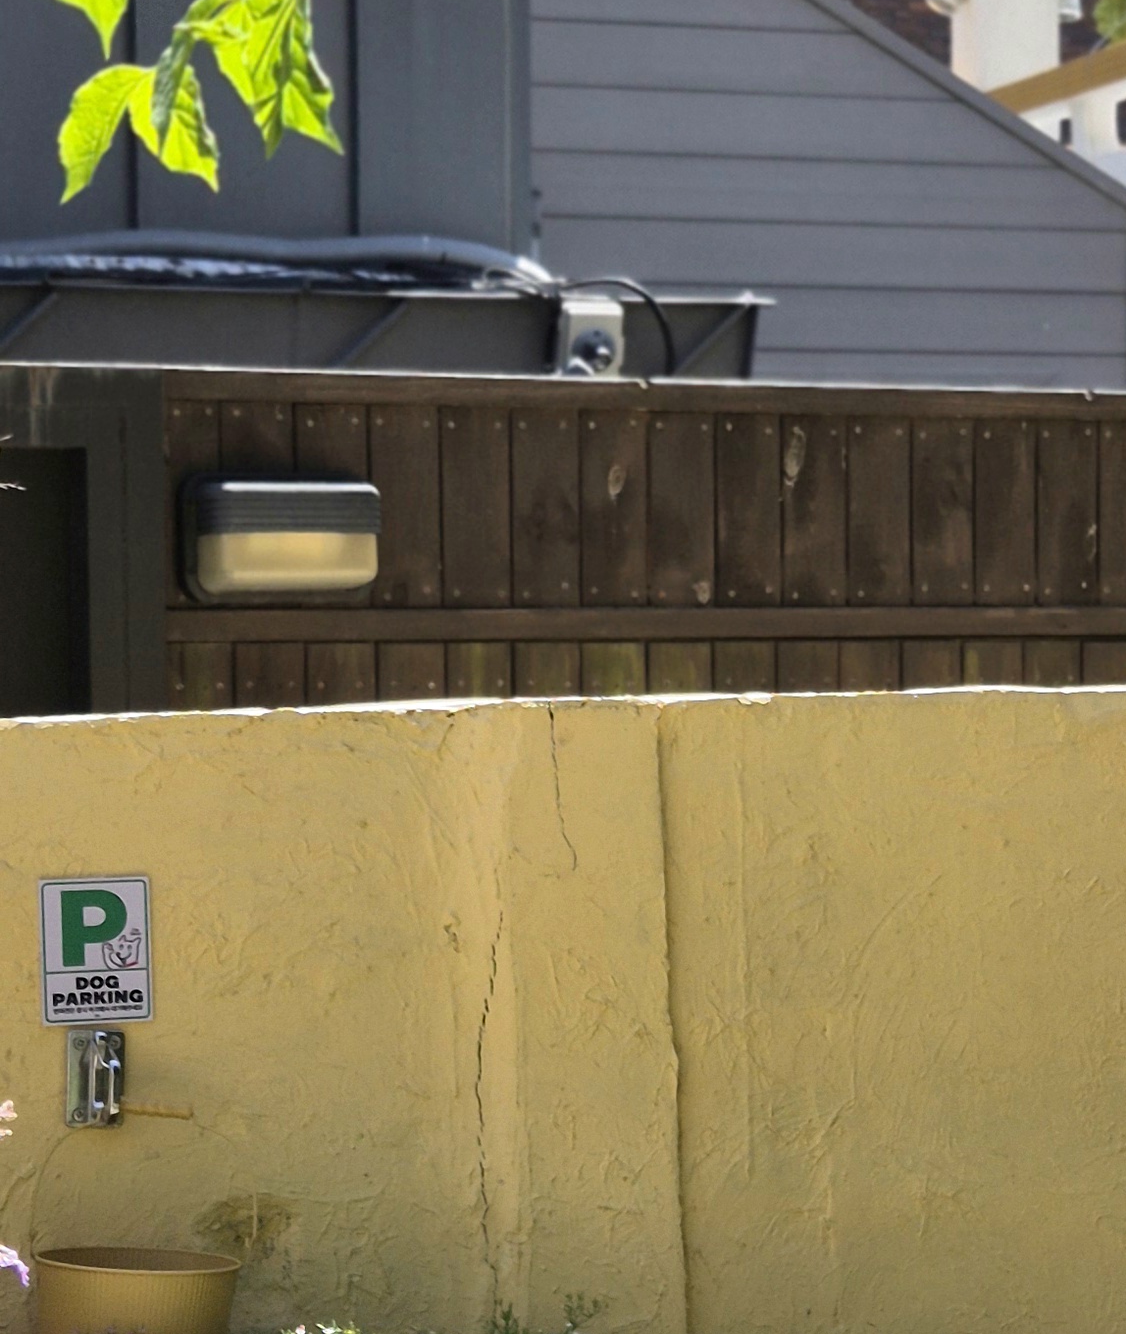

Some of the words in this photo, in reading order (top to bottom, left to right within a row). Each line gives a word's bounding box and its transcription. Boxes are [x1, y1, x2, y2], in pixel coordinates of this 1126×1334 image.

[60, 889, 127, 967] P
[76, 975, 120, 990] DOG
[52, 989, 144, 1007] PARKING
